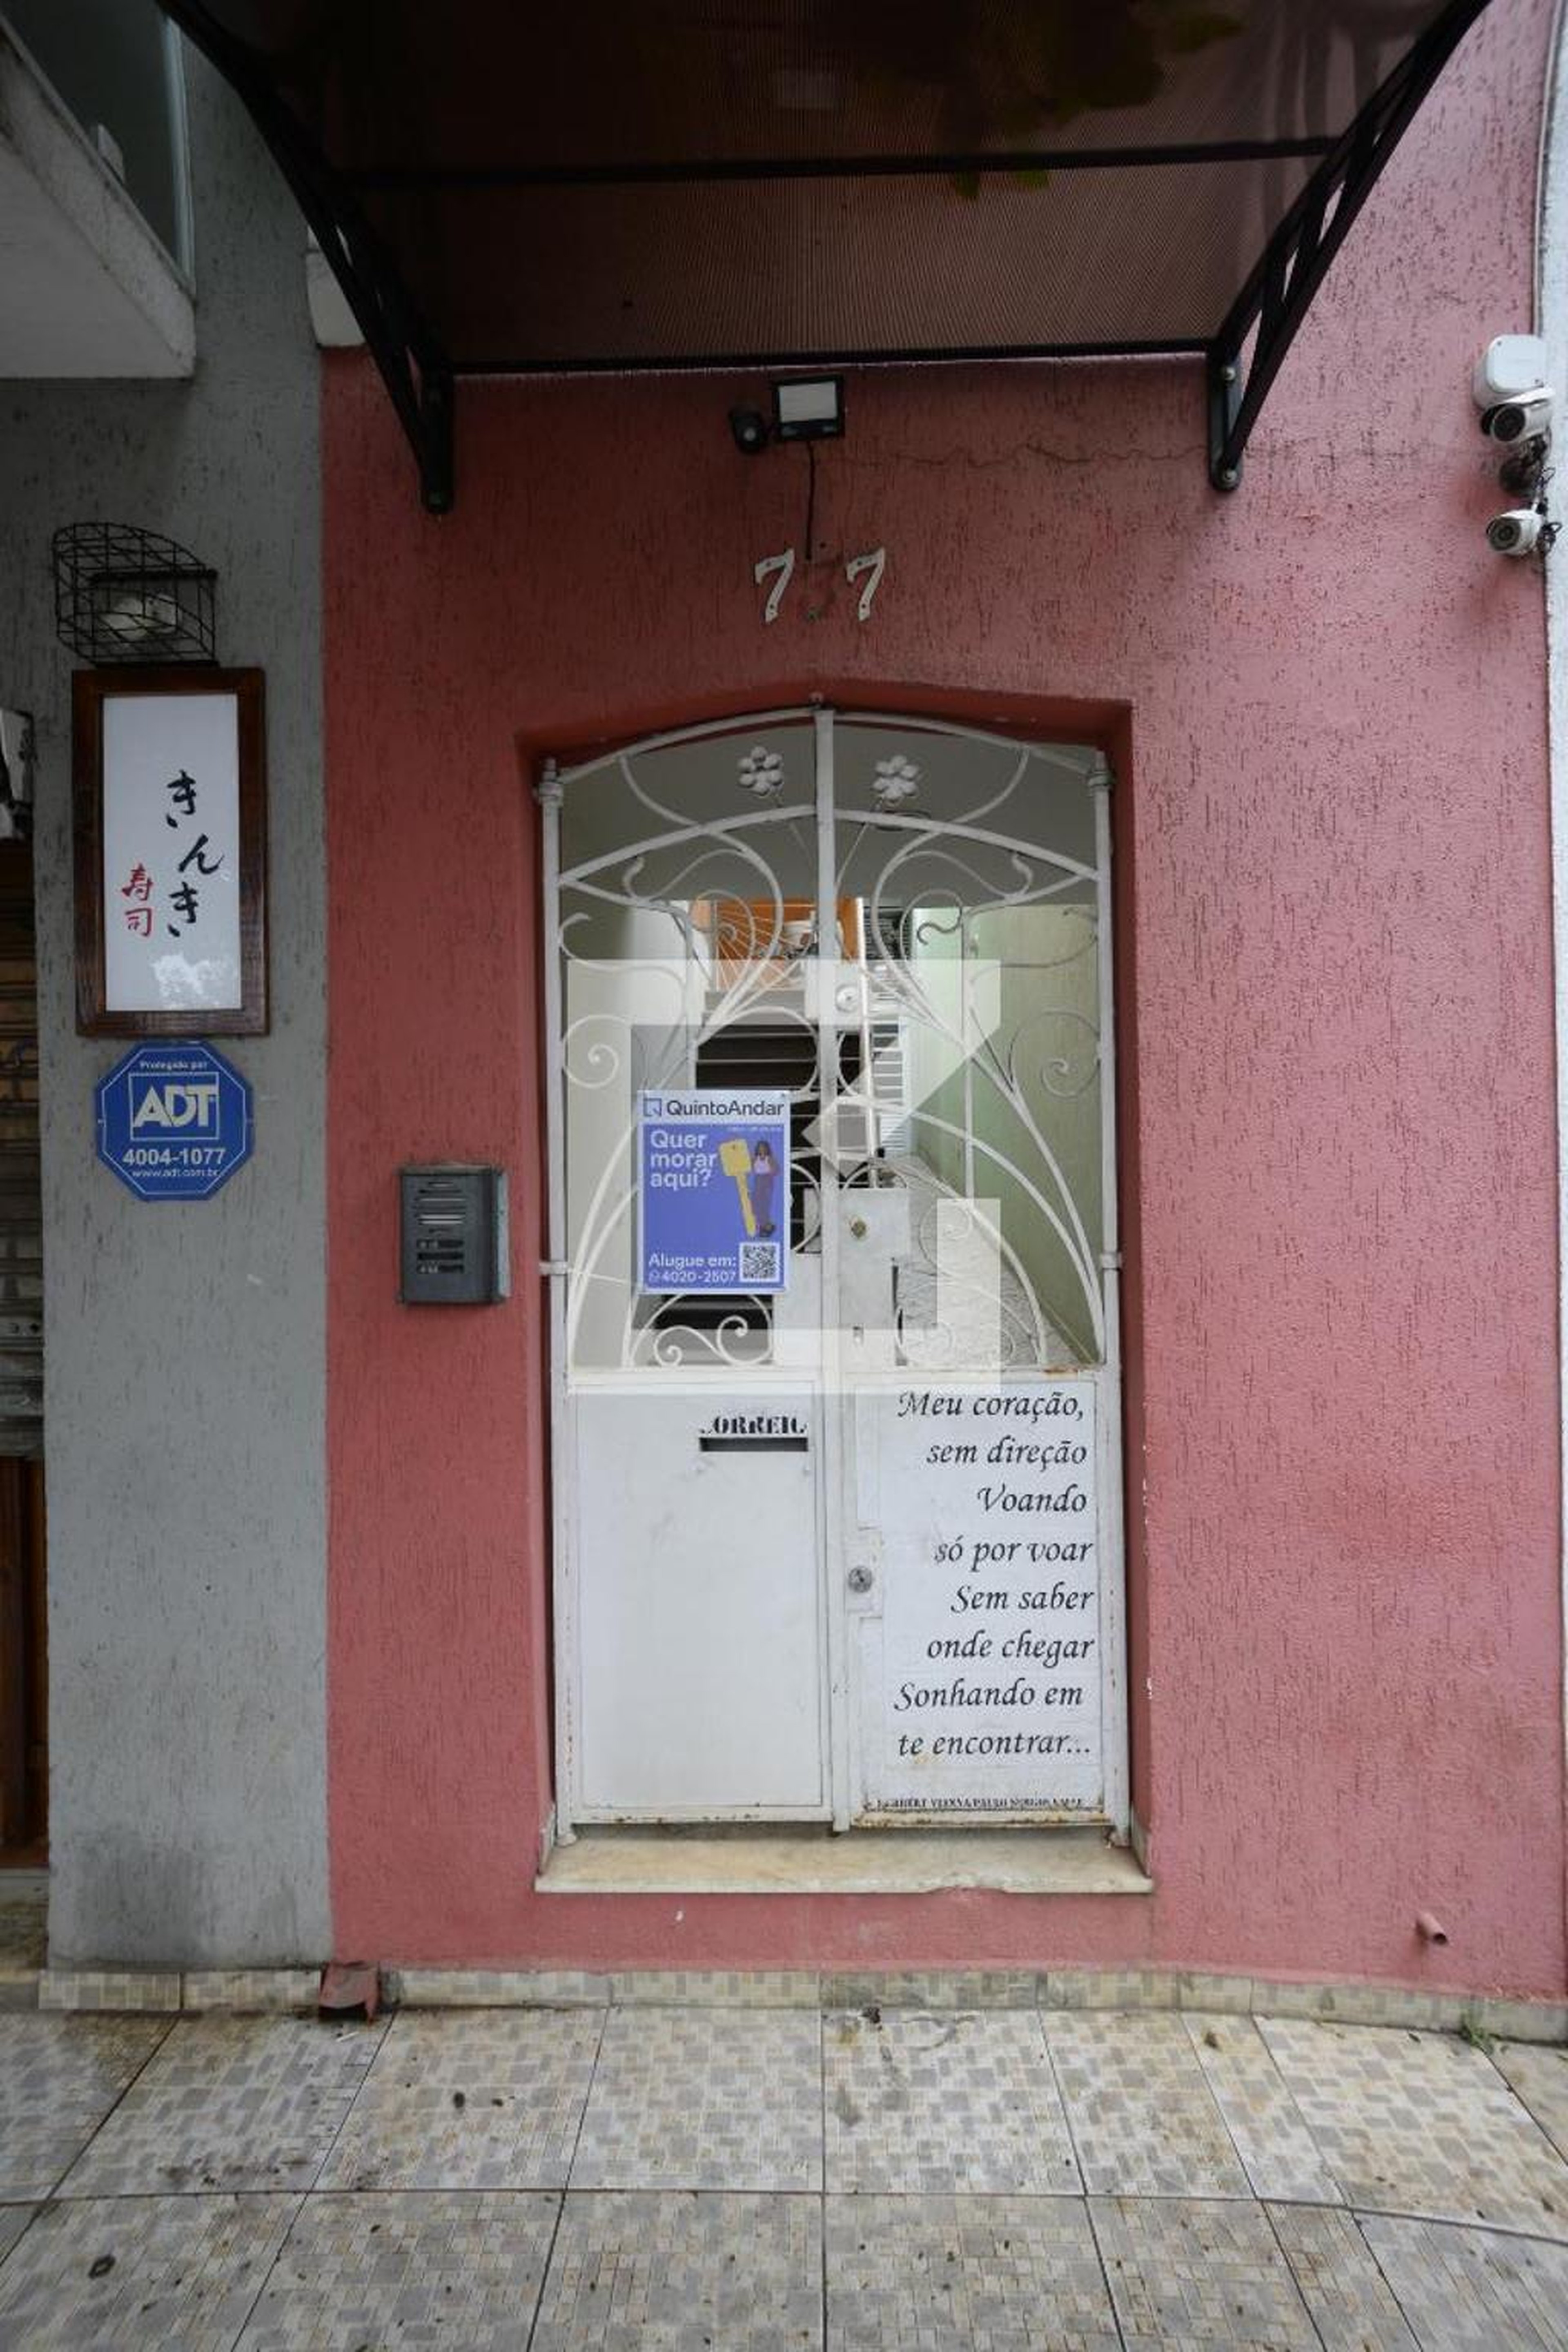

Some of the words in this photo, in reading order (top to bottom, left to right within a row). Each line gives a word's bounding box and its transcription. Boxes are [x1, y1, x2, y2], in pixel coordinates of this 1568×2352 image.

[165, 769, 226, 938] きんき
[122, 862, 154, 937] 寿司
[133, 1084, 219, 1128] ADT
[666, 1100, 784, 1116] QuintoAndar
[650, 1129, 708, 1148] Quer
[122, 1148, 227, 1166] 4004-1077
[650, 1152, 718, 1168] morar
[650, 1168, 712, 1191] aqui?
[649, 1252, 705, 1270] Alugue
[707, 1256, 737, 1267] em:
[898, 1392, 962, 1417] Meu
[973, 1391, 1083, 1422] coração,
[926, 1444, 978, 1464] sem
[987, 1434, 1087, 1472] direção
[977, 1483, 1087, 1512] Voando
[934, 1535, 963, 1563] só
[971, 1543, 1022, 1572] por
[1027, 1543, 1094, 1563] voar
[950, 1585, 1009, 1613] Sem
[1018, 1581, 1095, 1610] saber
[927, 1629, 993, 1659] onde
[1002, 1629, 1095, 1669] chegar
[893, 1677, 1036, 1711] Sonhando
[1044, 1687, 1082, 1706] em
[898, 1735, 924, 1756] te
[933, 1733, 1090, 1755] encontrar...
